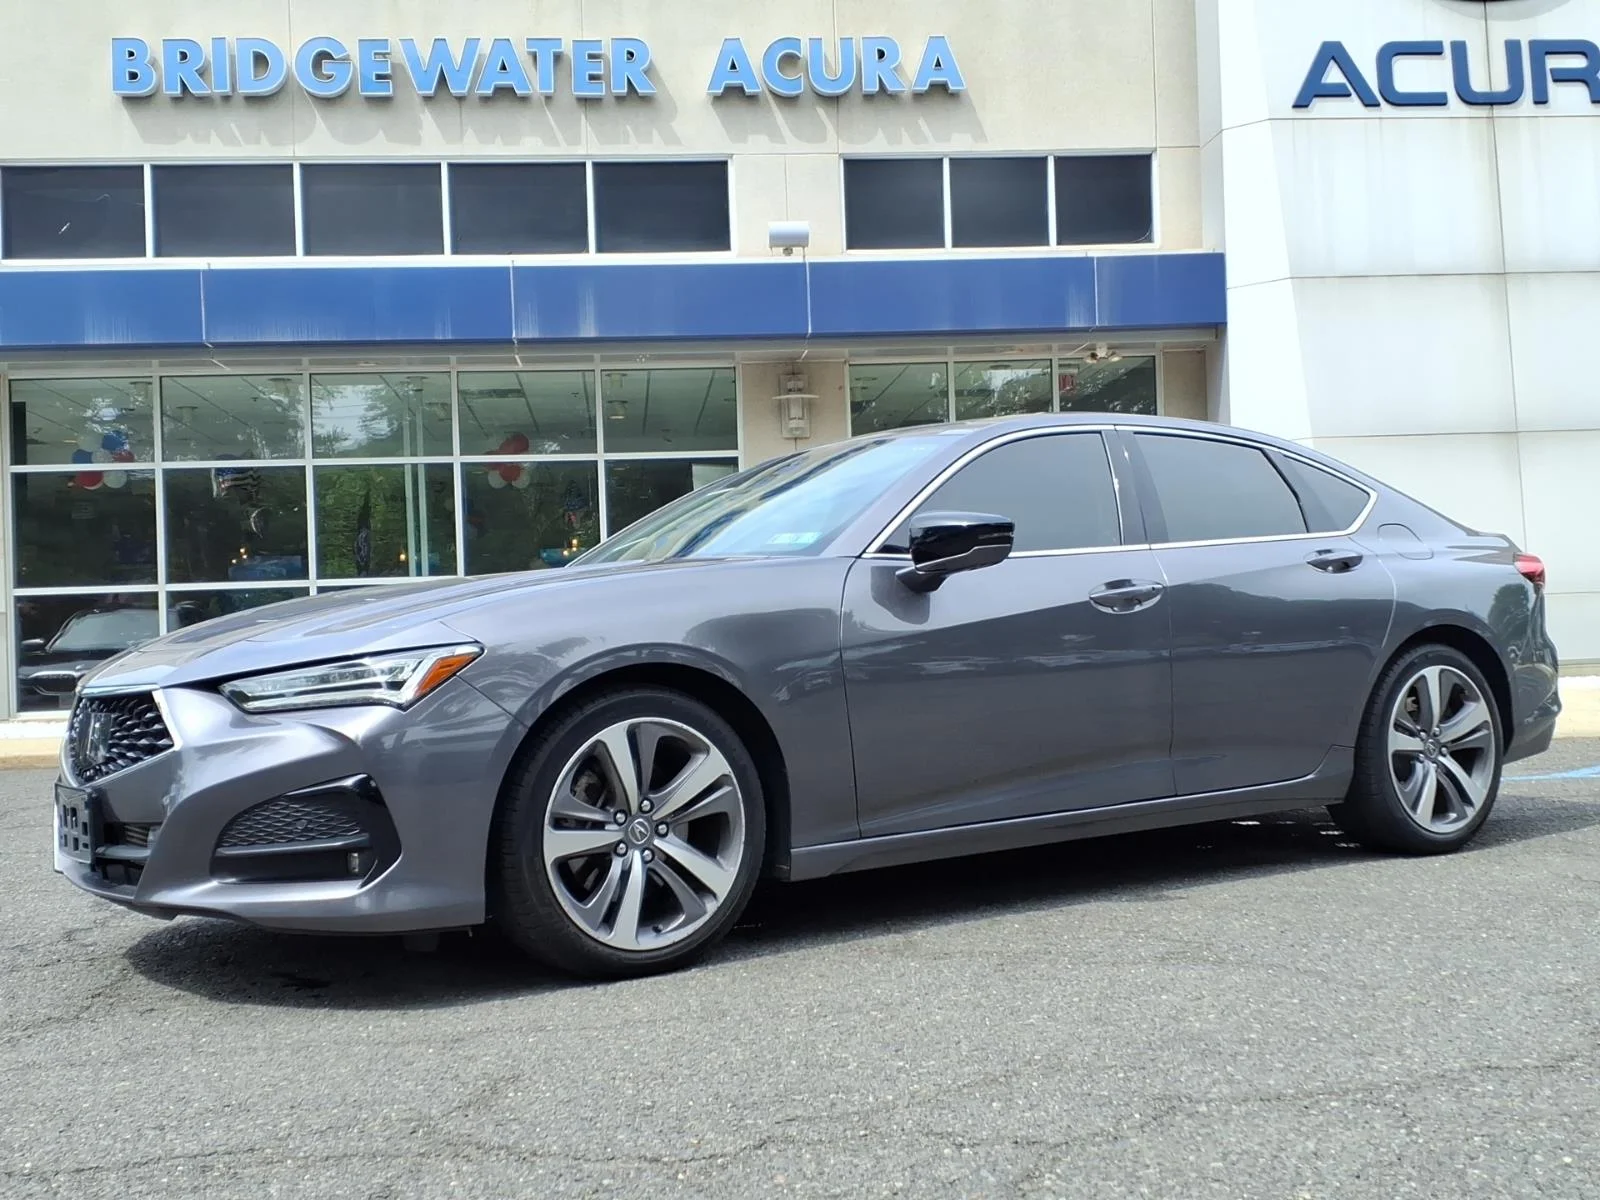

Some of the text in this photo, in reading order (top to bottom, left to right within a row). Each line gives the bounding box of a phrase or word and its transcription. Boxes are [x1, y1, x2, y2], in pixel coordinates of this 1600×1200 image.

[111, 35, 965, 99] BRIDGEWATER ACURA
[1292, 39, 1600, 108] ACUR
